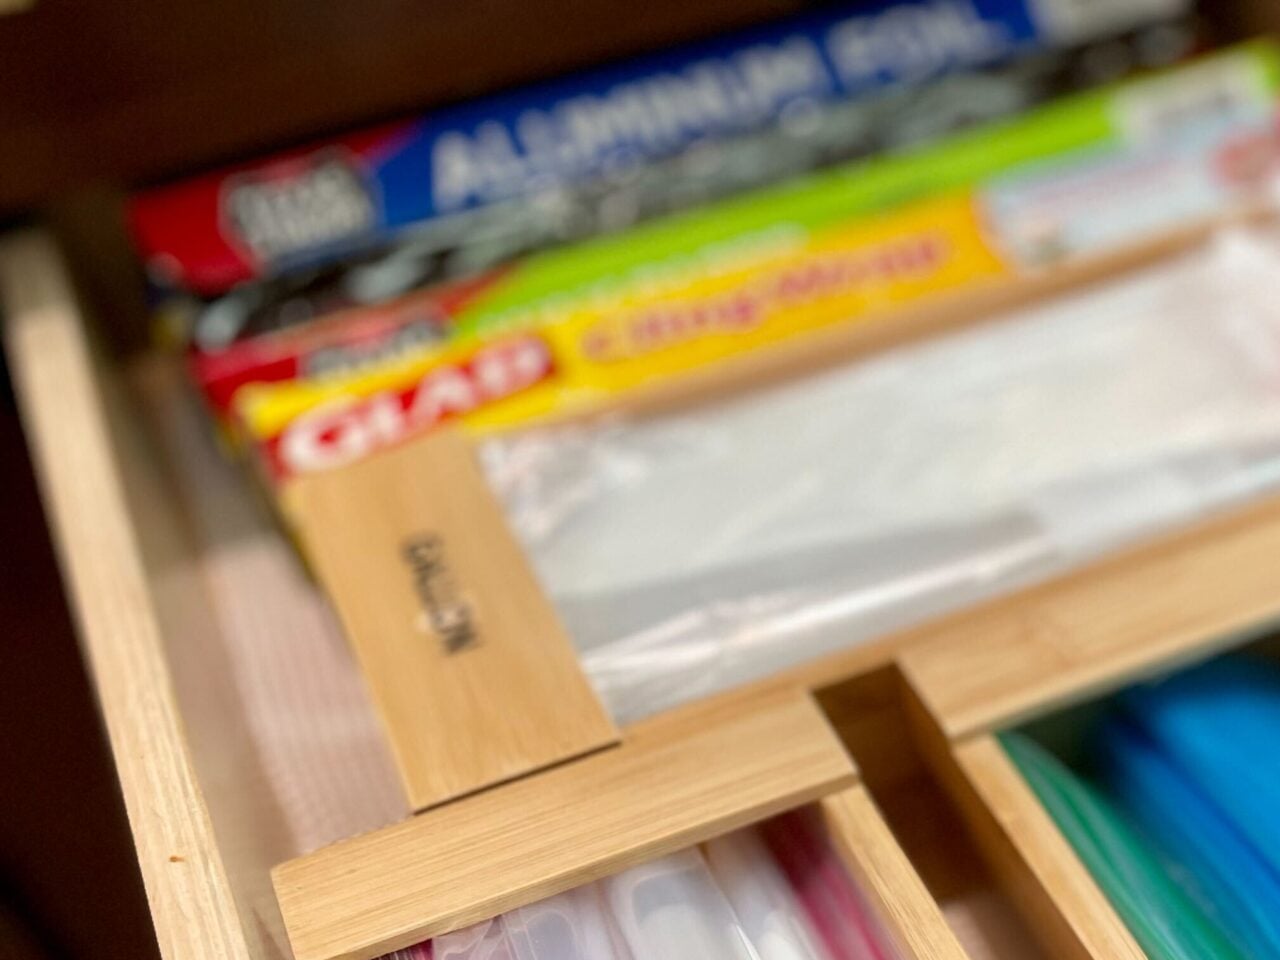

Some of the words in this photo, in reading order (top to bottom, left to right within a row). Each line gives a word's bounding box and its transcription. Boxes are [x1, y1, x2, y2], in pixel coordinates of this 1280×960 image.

[432, 34, 828, 212] ALUMINUM
[824, 2, 1008, 92] FOIL
[278, 334, 554, 474] GLAD
